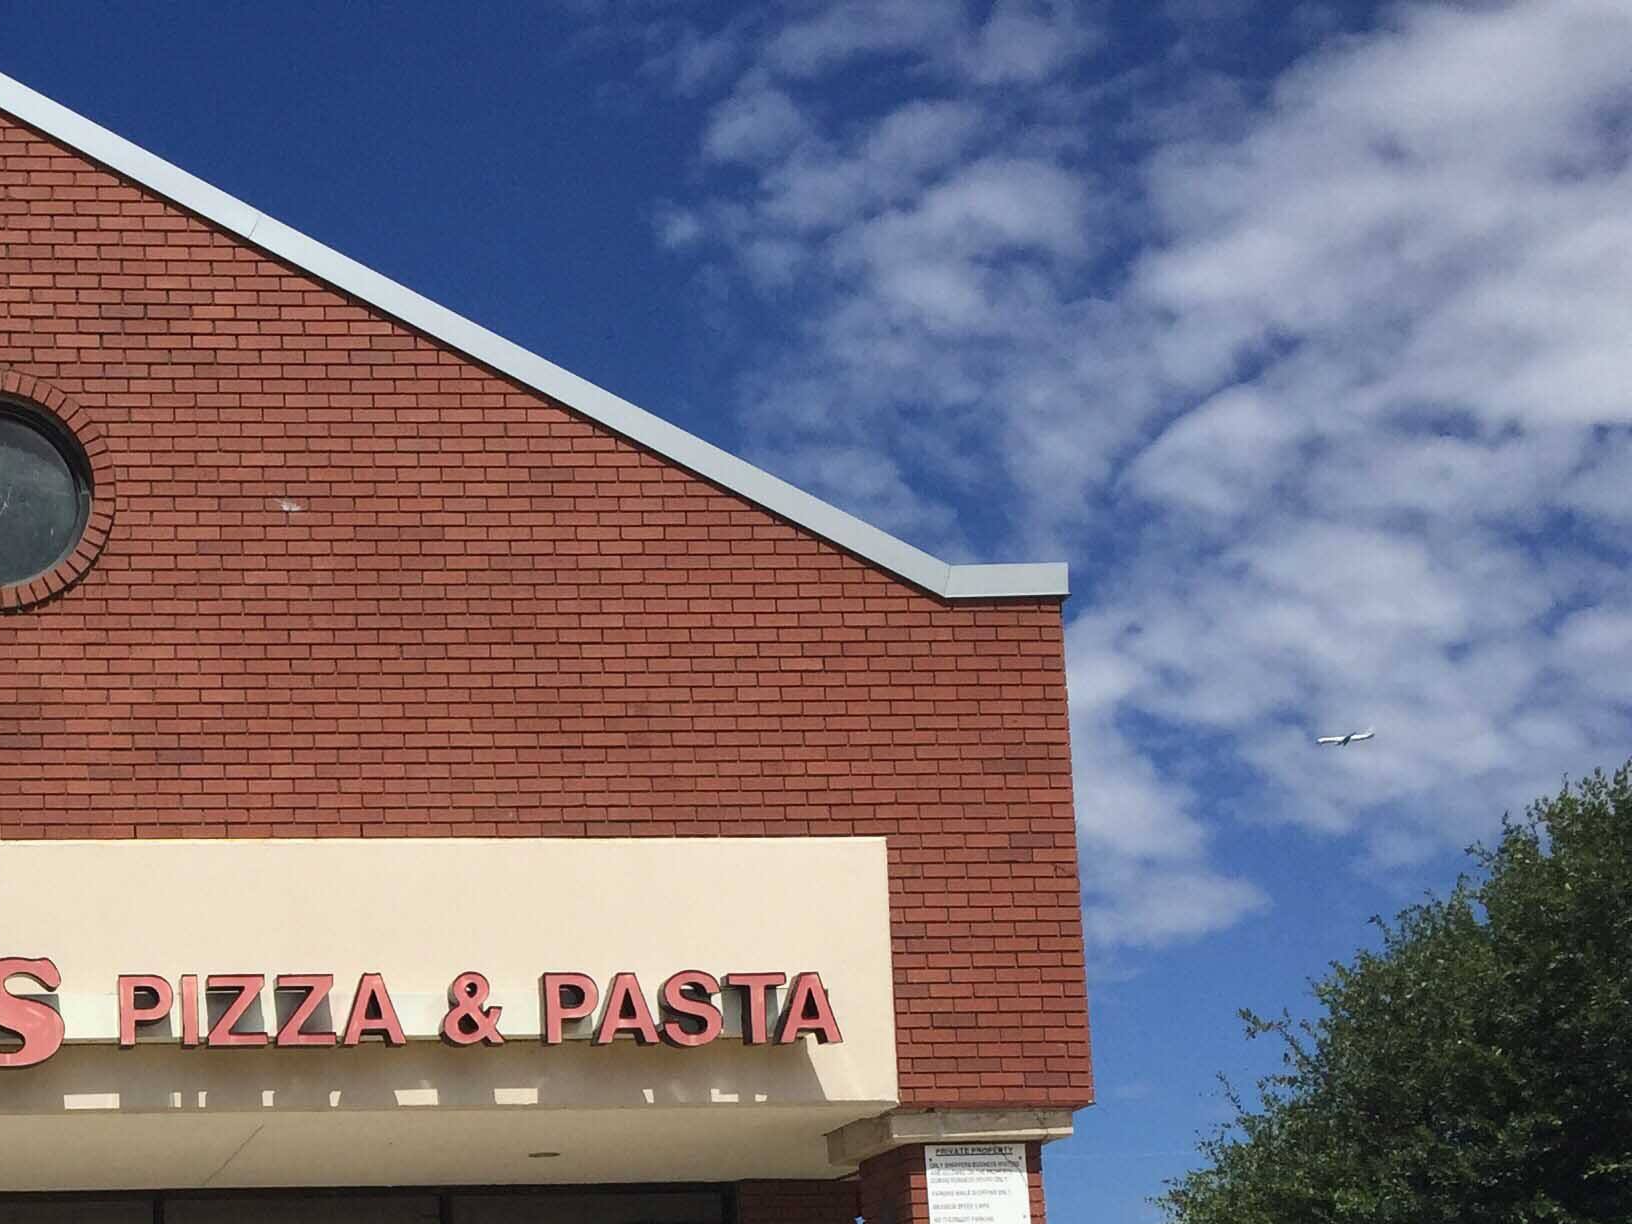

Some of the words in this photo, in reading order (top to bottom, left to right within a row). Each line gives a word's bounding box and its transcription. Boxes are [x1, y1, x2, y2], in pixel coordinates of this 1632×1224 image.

[116, 972, 407, 1048] PIZZA
[439, 971, 506, 1047] &
[541, 970, 844, 1047] PASTA
